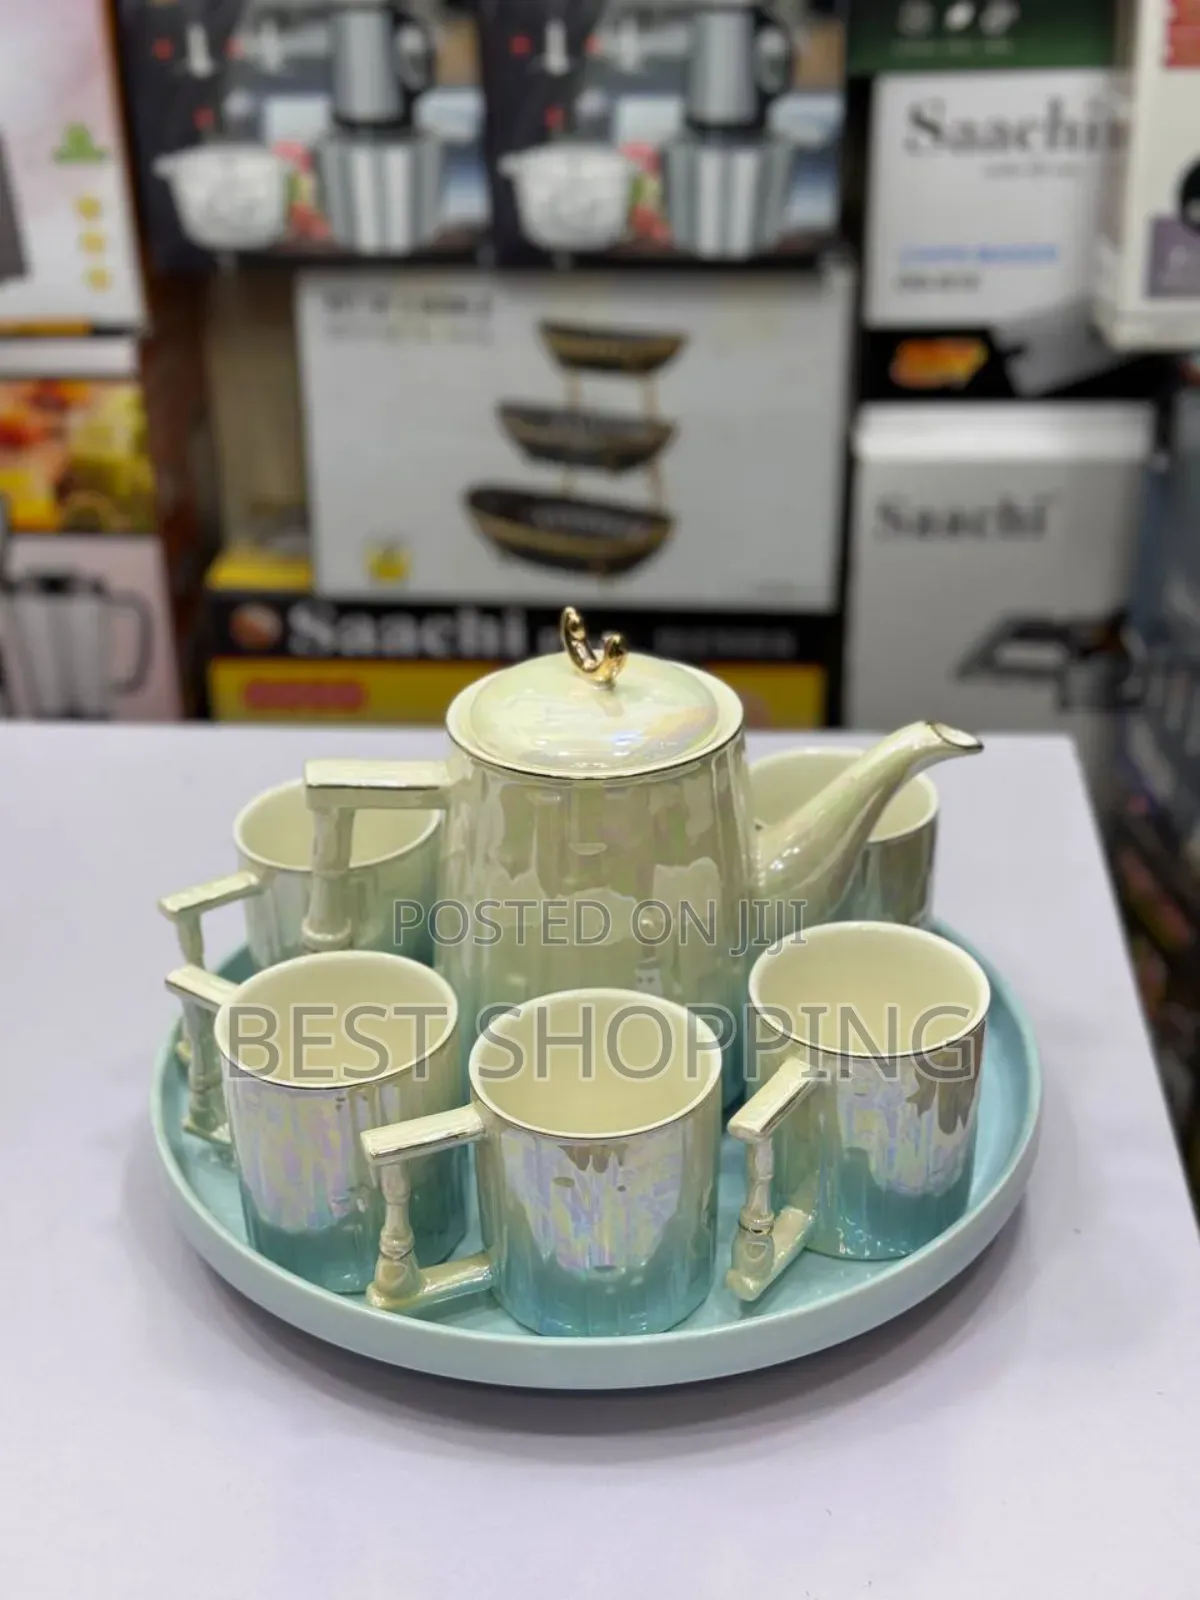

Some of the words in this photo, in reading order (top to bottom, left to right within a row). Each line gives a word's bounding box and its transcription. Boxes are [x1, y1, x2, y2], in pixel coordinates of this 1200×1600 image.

[903, 97, 1104, 157] Saachi
[871, 491, 1050, 542] Saachi
[287, 600, 528, 657] Saachi
